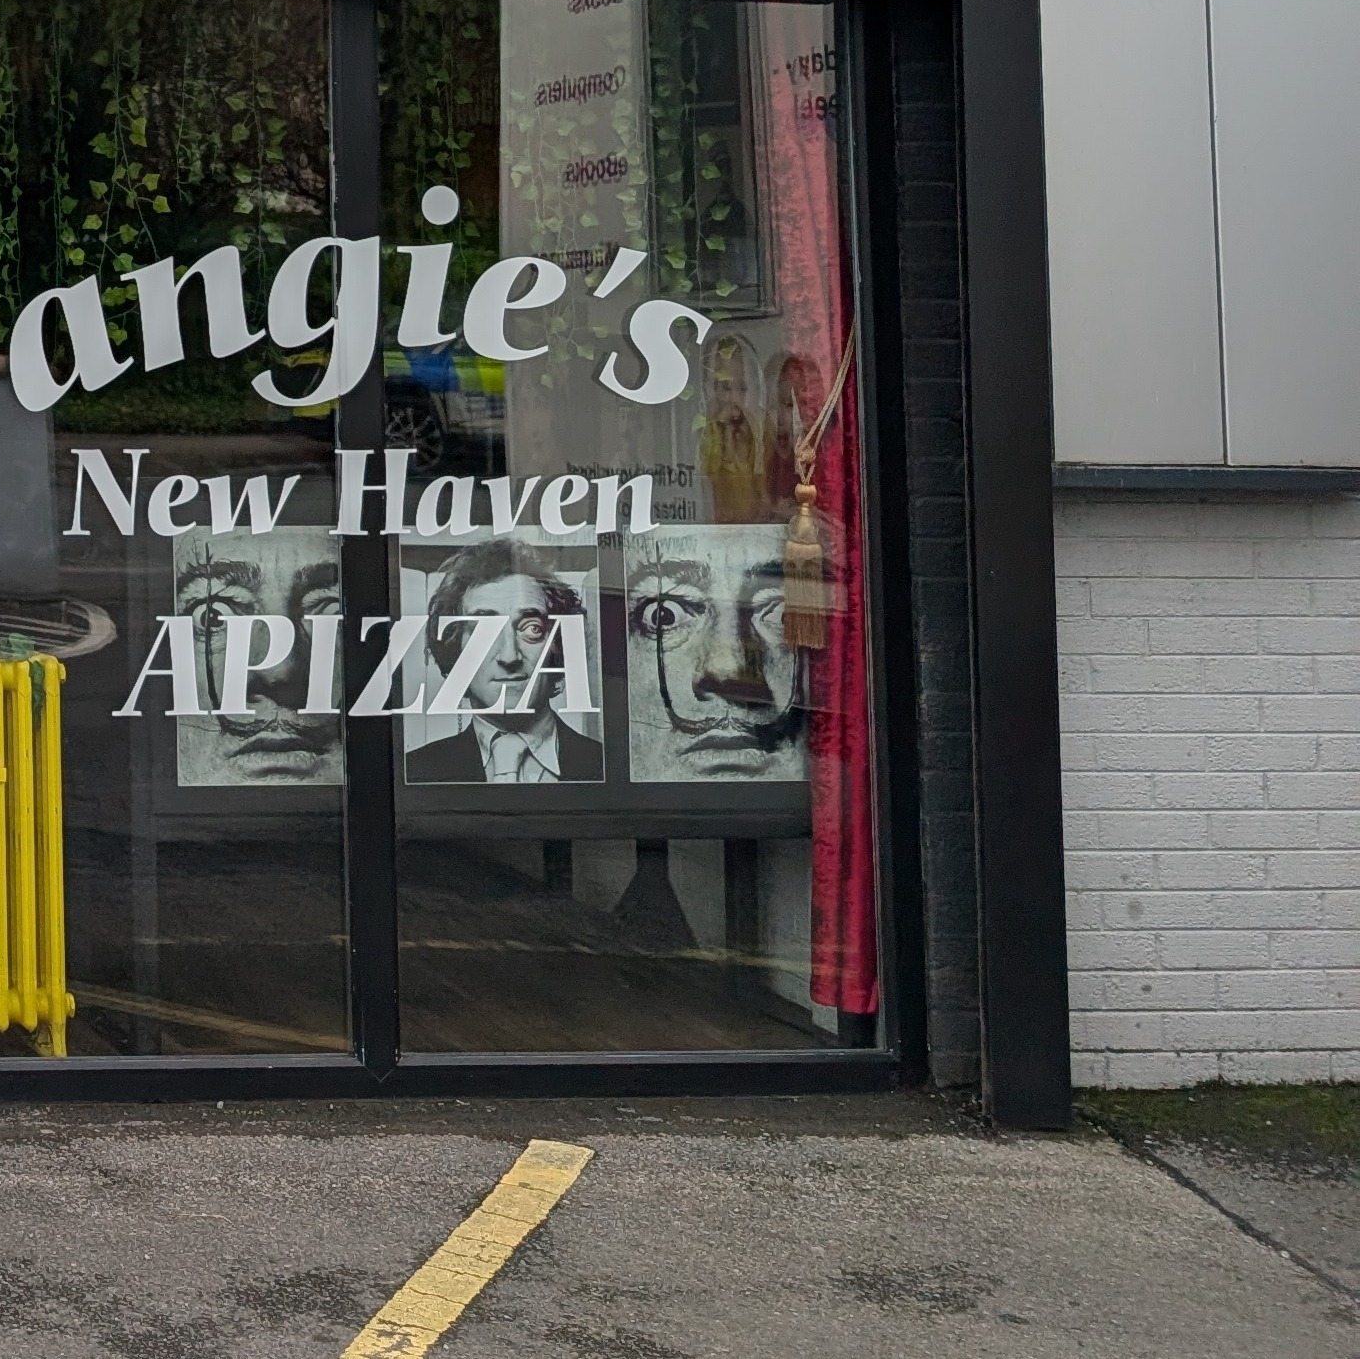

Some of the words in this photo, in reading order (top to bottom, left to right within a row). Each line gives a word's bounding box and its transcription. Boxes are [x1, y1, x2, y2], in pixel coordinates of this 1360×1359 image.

[9, 185, 714, 413] angie's
[63, 447, 301, 537] New
[327, 447, 660, 537] Haven
[111, 613, 600, 719] APIZZA
